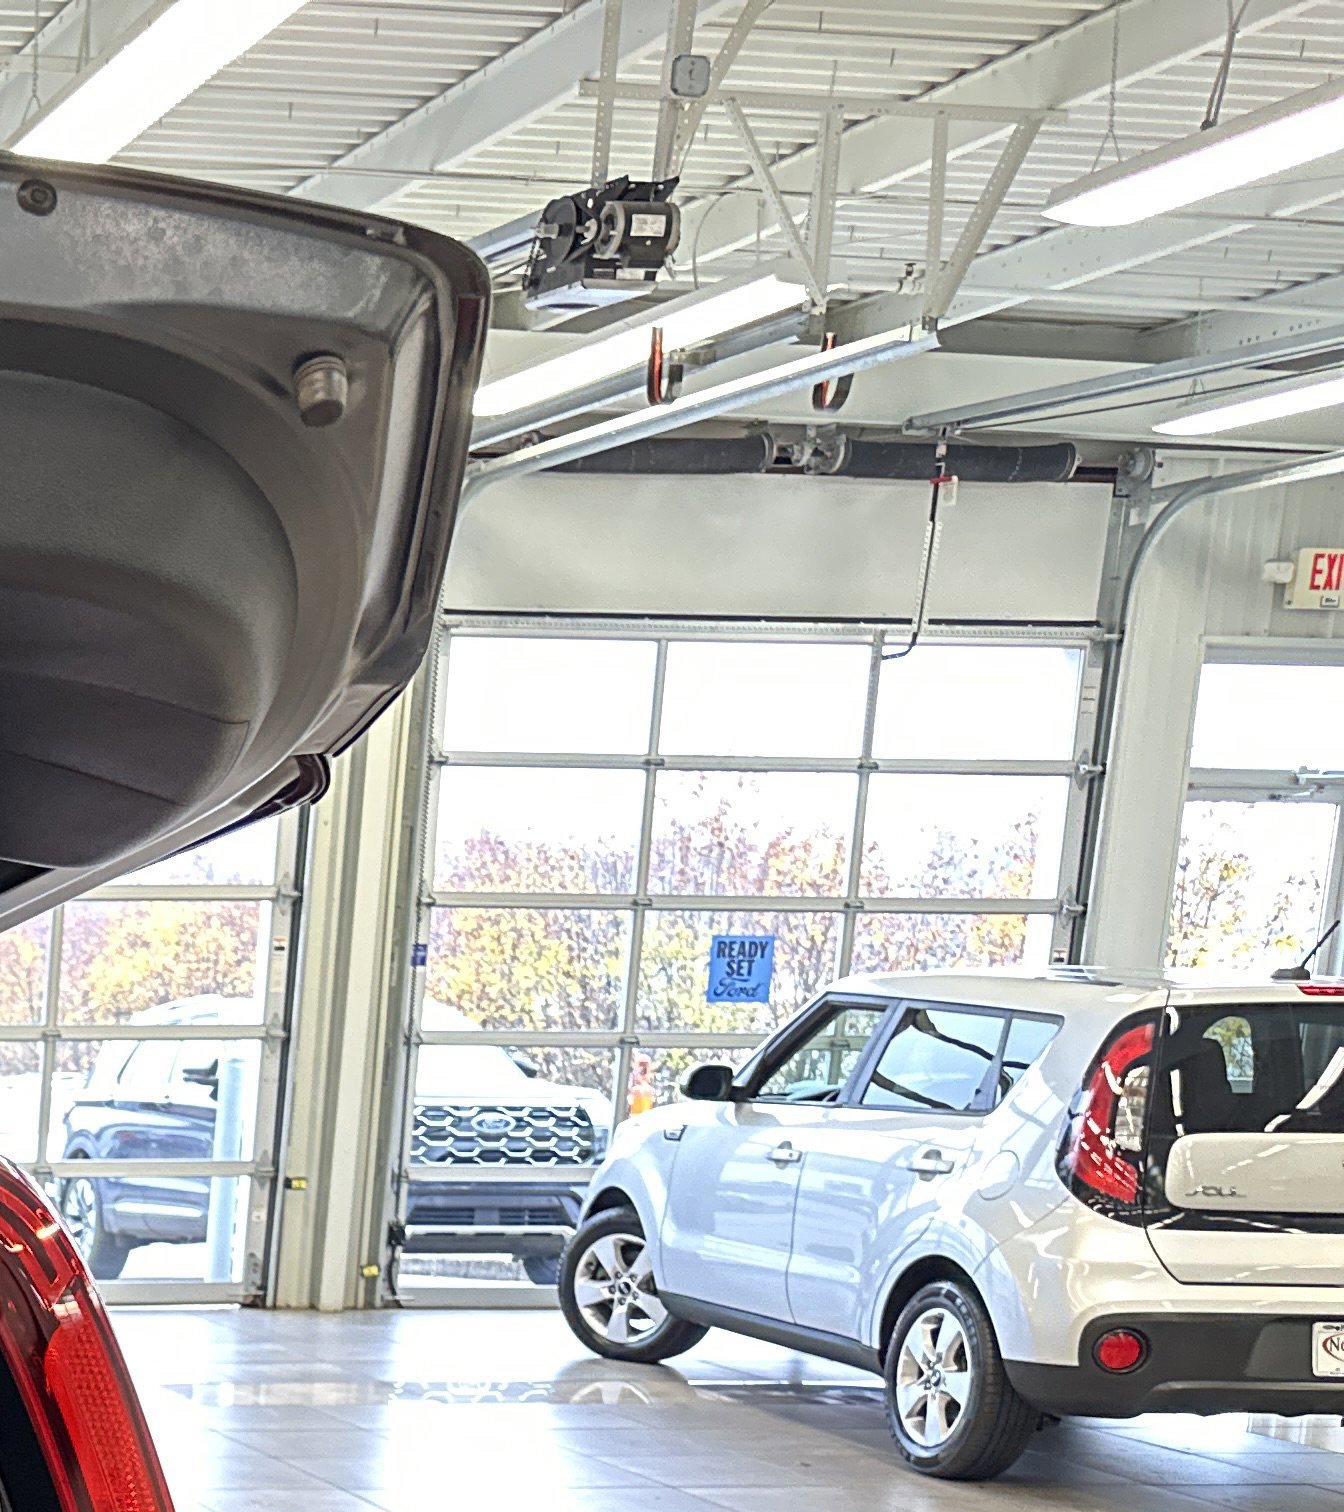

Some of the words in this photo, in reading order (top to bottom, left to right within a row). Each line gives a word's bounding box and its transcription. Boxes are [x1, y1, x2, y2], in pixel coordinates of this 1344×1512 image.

[716, 940, 769, 959] READY
[725, 959, 755, 977] SET
[713, 977, 765, 997] Ford
